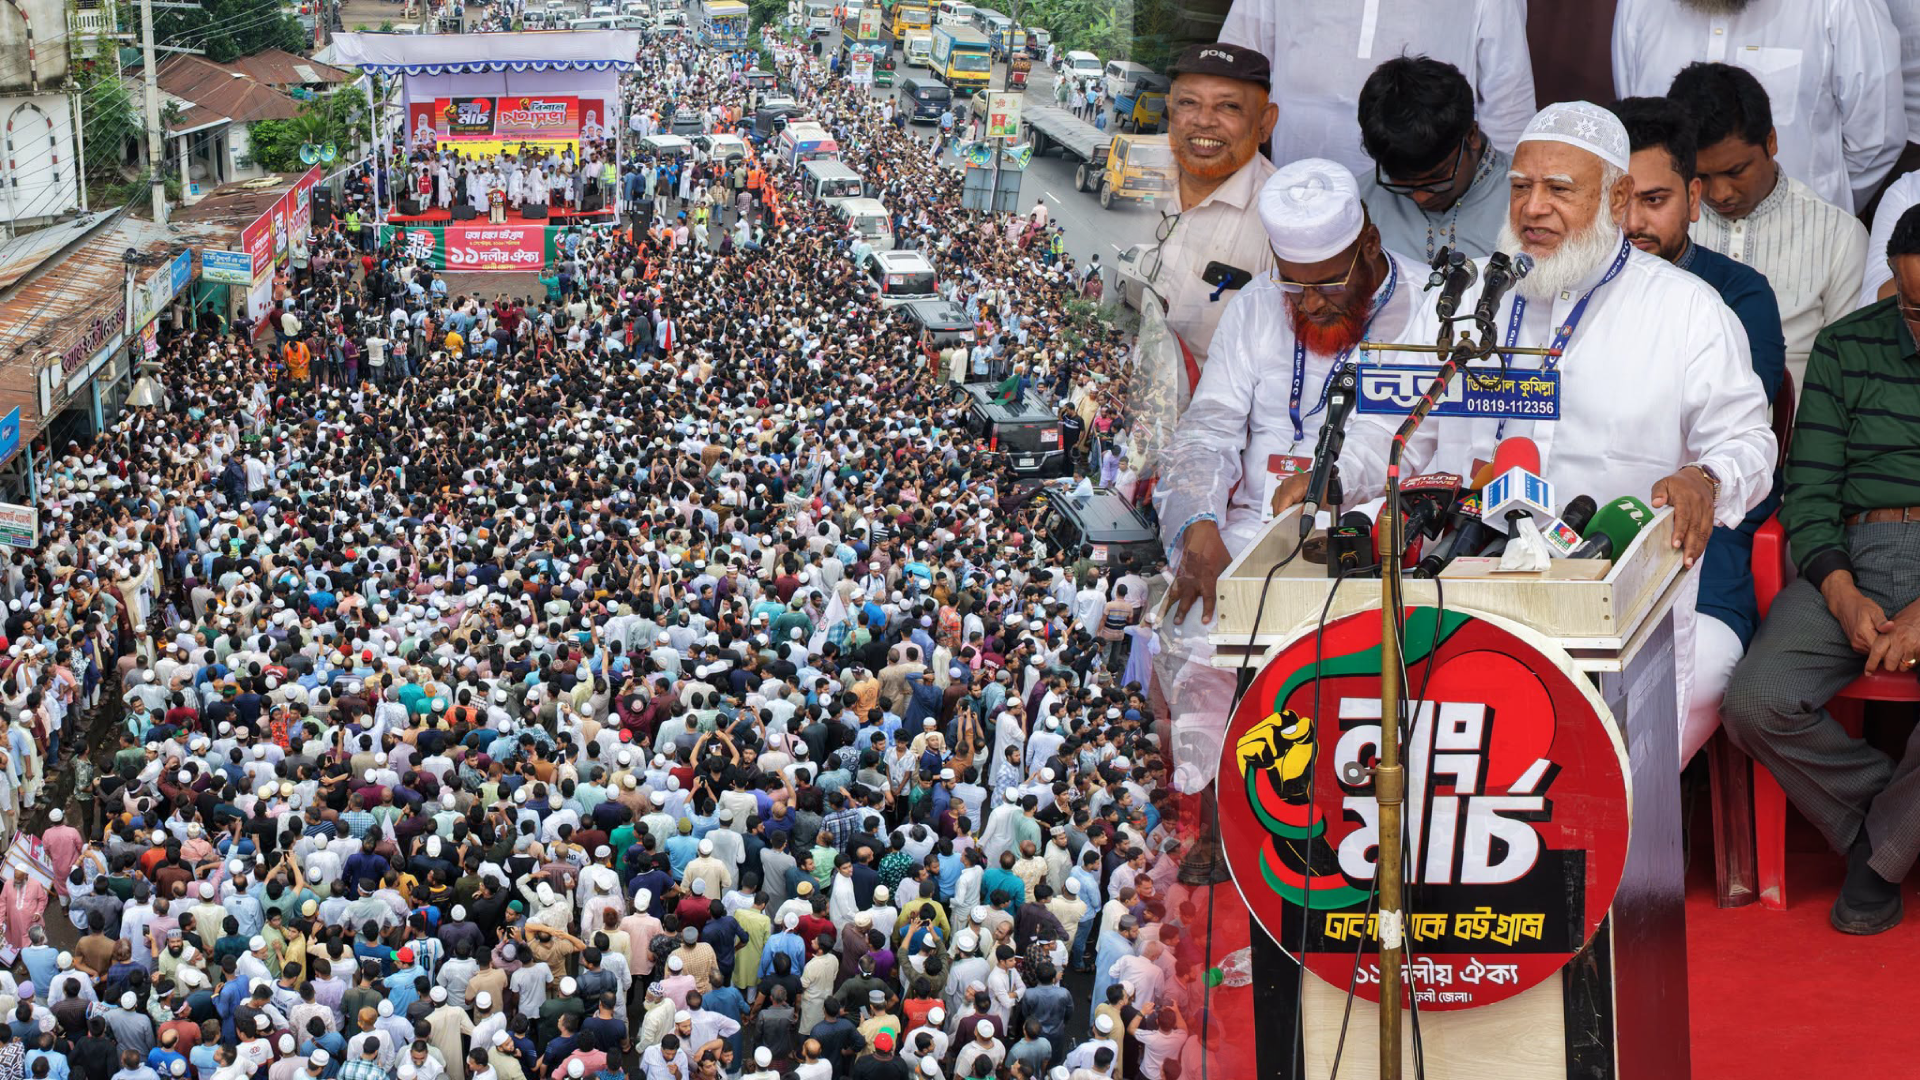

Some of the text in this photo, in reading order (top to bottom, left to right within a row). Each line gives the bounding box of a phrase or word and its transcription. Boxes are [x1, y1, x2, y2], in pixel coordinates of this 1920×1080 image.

[457, 109, 490, 125] মার্চ
[530, 100, 567, 113] বিশাল
[451, 247, 540, 264] ১১ দলীয় ঐক্য
[1519, 376, 1555, 398] কুমিল্লা
[1467, 399, 1554, 414] 01819-112356
[1498, 478, 1504, 505] 1
[1536, 482, 1544, 507] 1
[1334, 697, 1490, 795] লং
[1338, 758, 1552, 885] মার্চ
[1324, 912, 1379, 942] ঢাকা
[1454, 906, 1545, 947] চট্টগ্রাম
[1459, 957, 1519, 985] ঐক্য
[1439, 992, 1473, 1003] জেলা।
